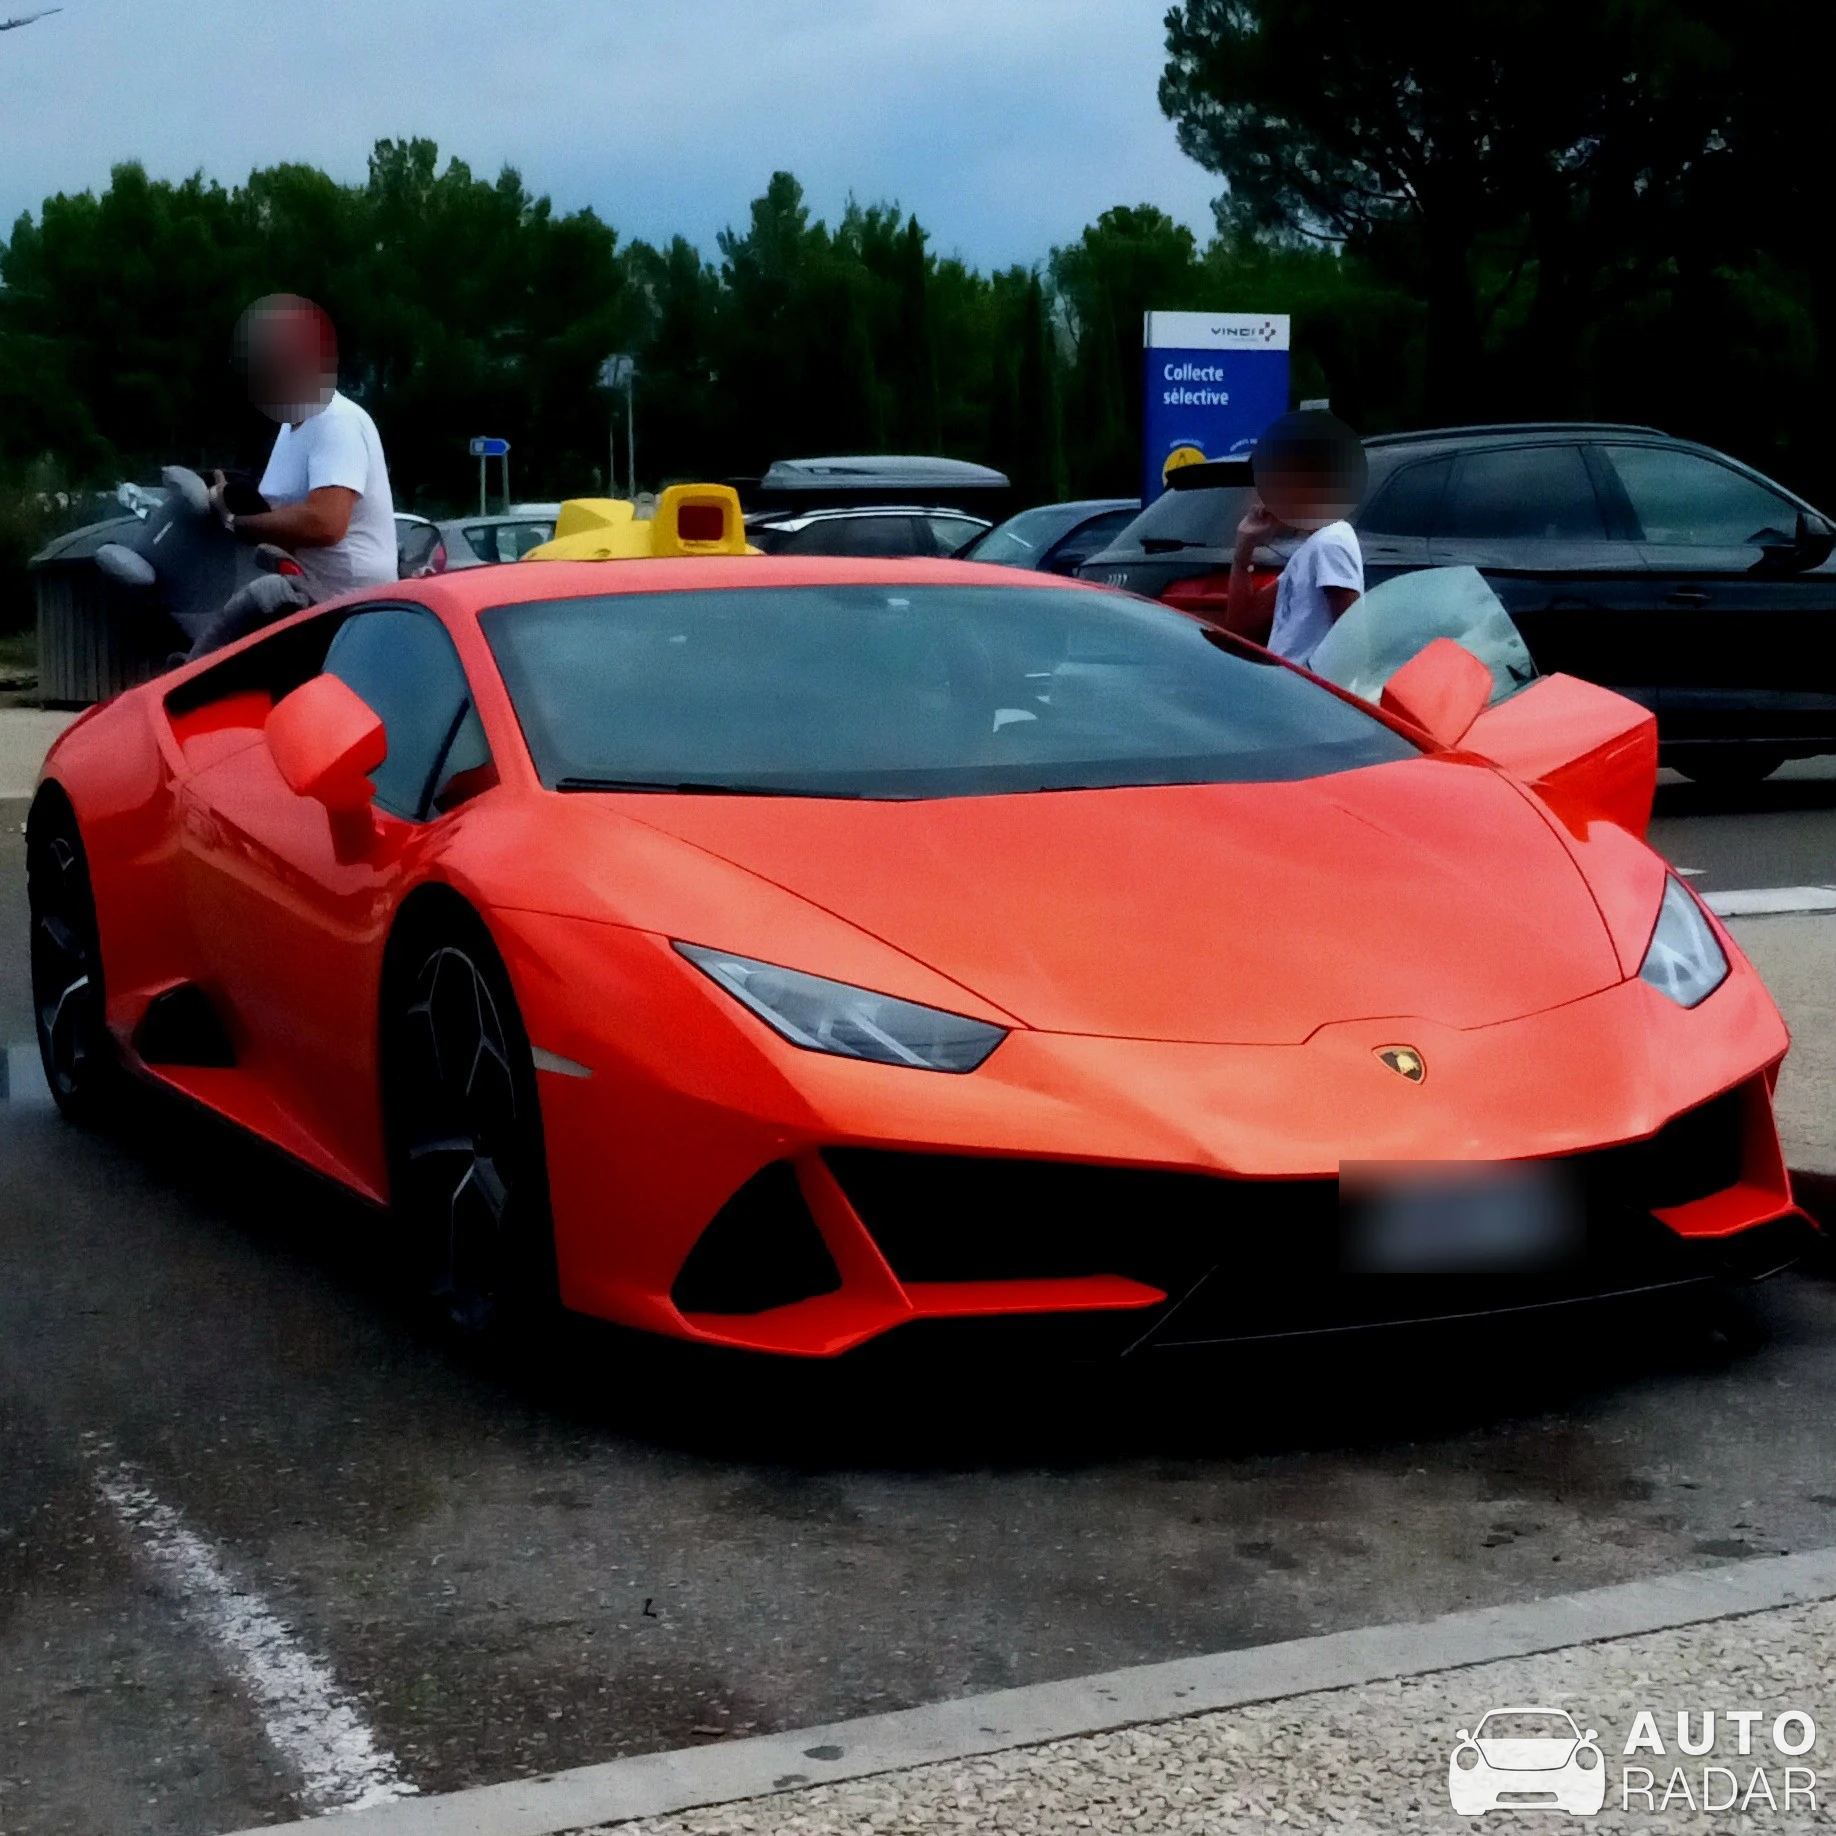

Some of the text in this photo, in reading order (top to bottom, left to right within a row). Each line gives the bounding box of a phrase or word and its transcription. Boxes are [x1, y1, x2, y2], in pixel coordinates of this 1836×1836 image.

[1211, 328, 1256, 336] VINCI
[1163, 363, 1224, 381] Collecte
[1163, 387, 1229, 405] sélective
